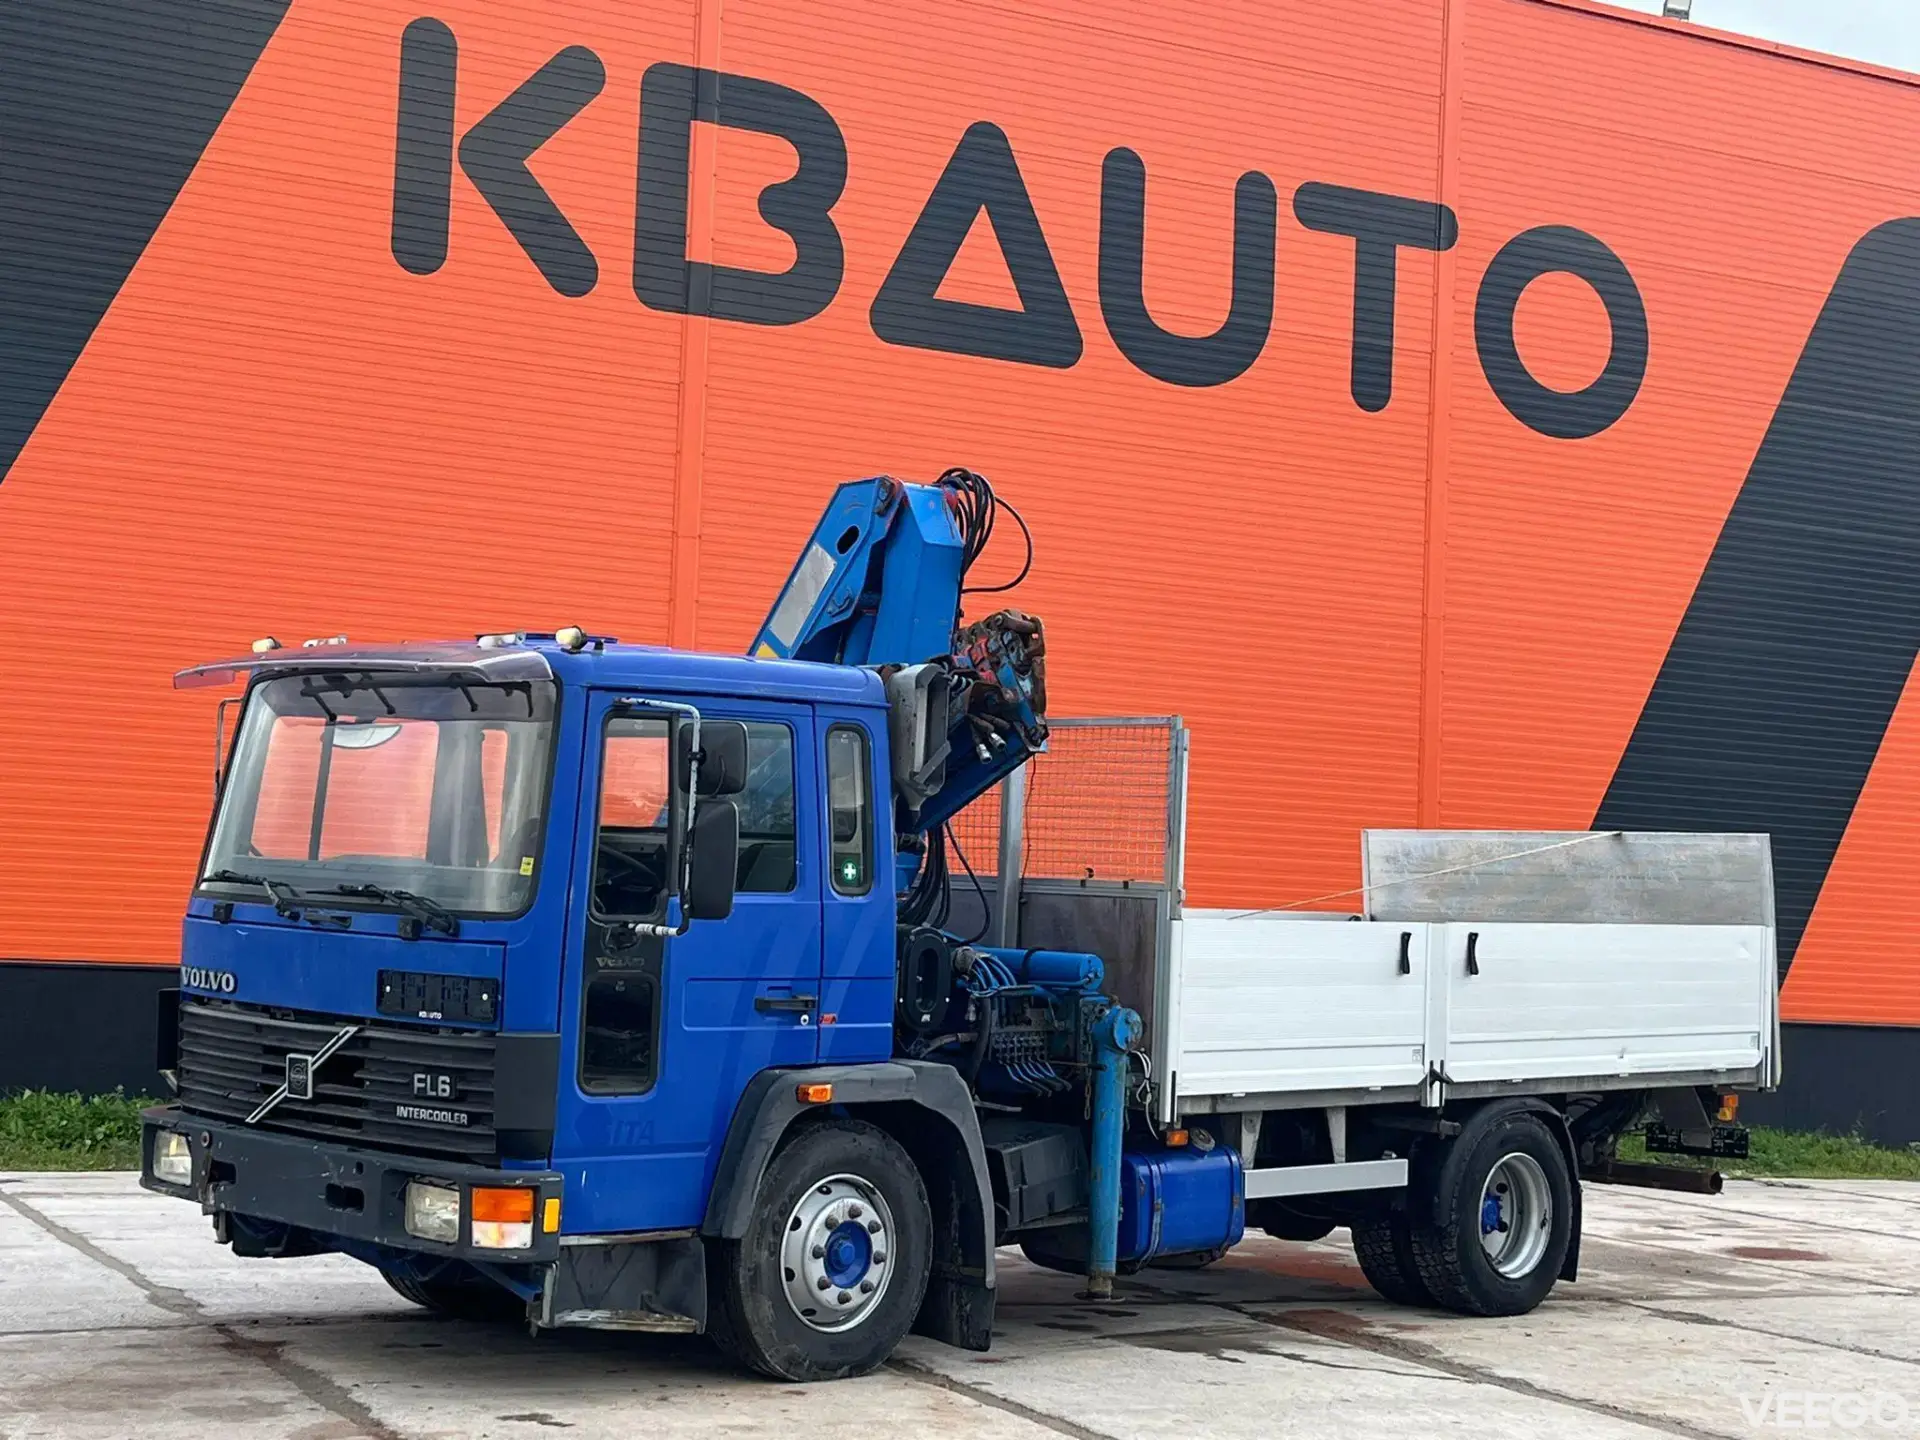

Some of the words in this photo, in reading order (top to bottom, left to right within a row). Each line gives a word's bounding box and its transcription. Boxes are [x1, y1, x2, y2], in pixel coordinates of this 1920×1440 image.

[391, 17, 1648, 439] KBAUTO
[181, 966, 235, 992] VOLVO
[413, 1073, 451, 1097] FL6
[396, 1105, 468, 1125] INTERCOOLER
